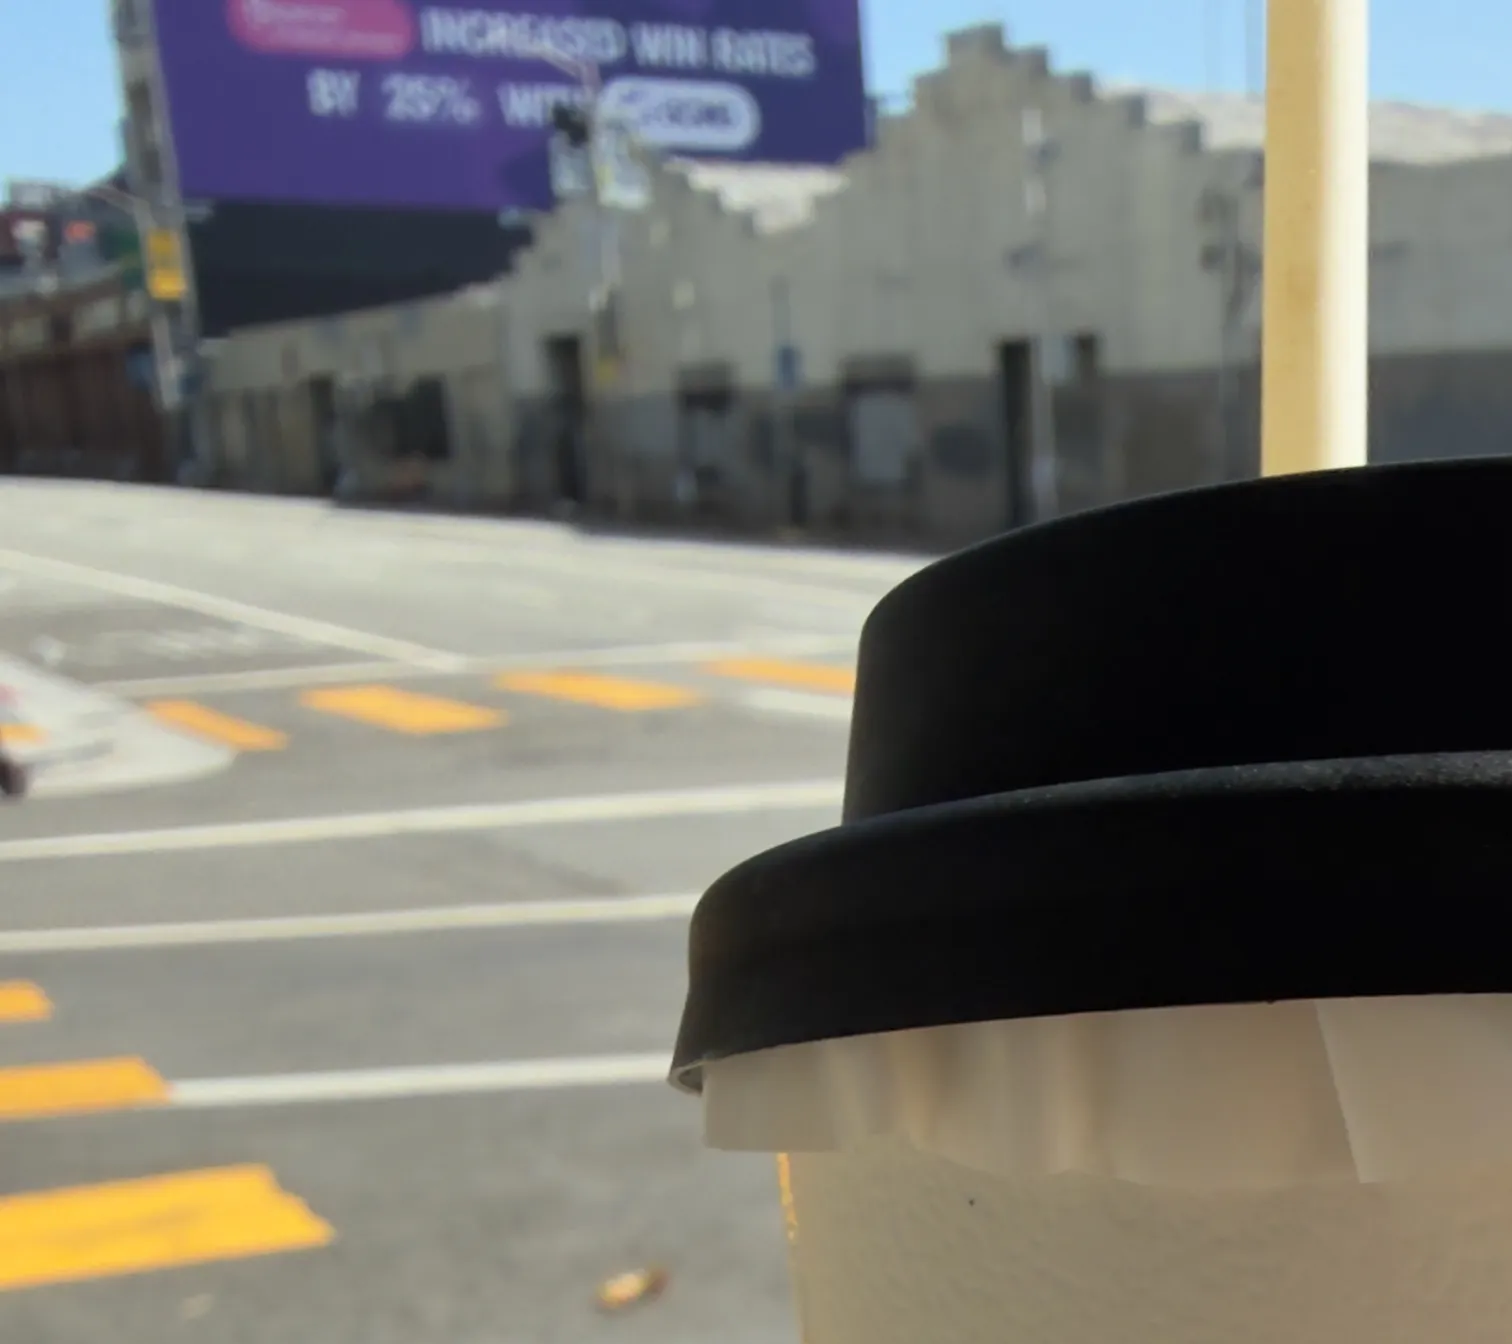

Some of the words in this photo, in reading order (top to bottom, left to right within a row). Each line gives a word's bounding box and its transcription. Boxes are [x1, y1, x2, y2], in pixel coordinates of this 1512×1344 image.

[420, 7, 627, 64] INCREASED
[630, 21, 707, 69] WIN
[710, 26, 817, 78] RATES
[306, 68, 361, 118] BY
